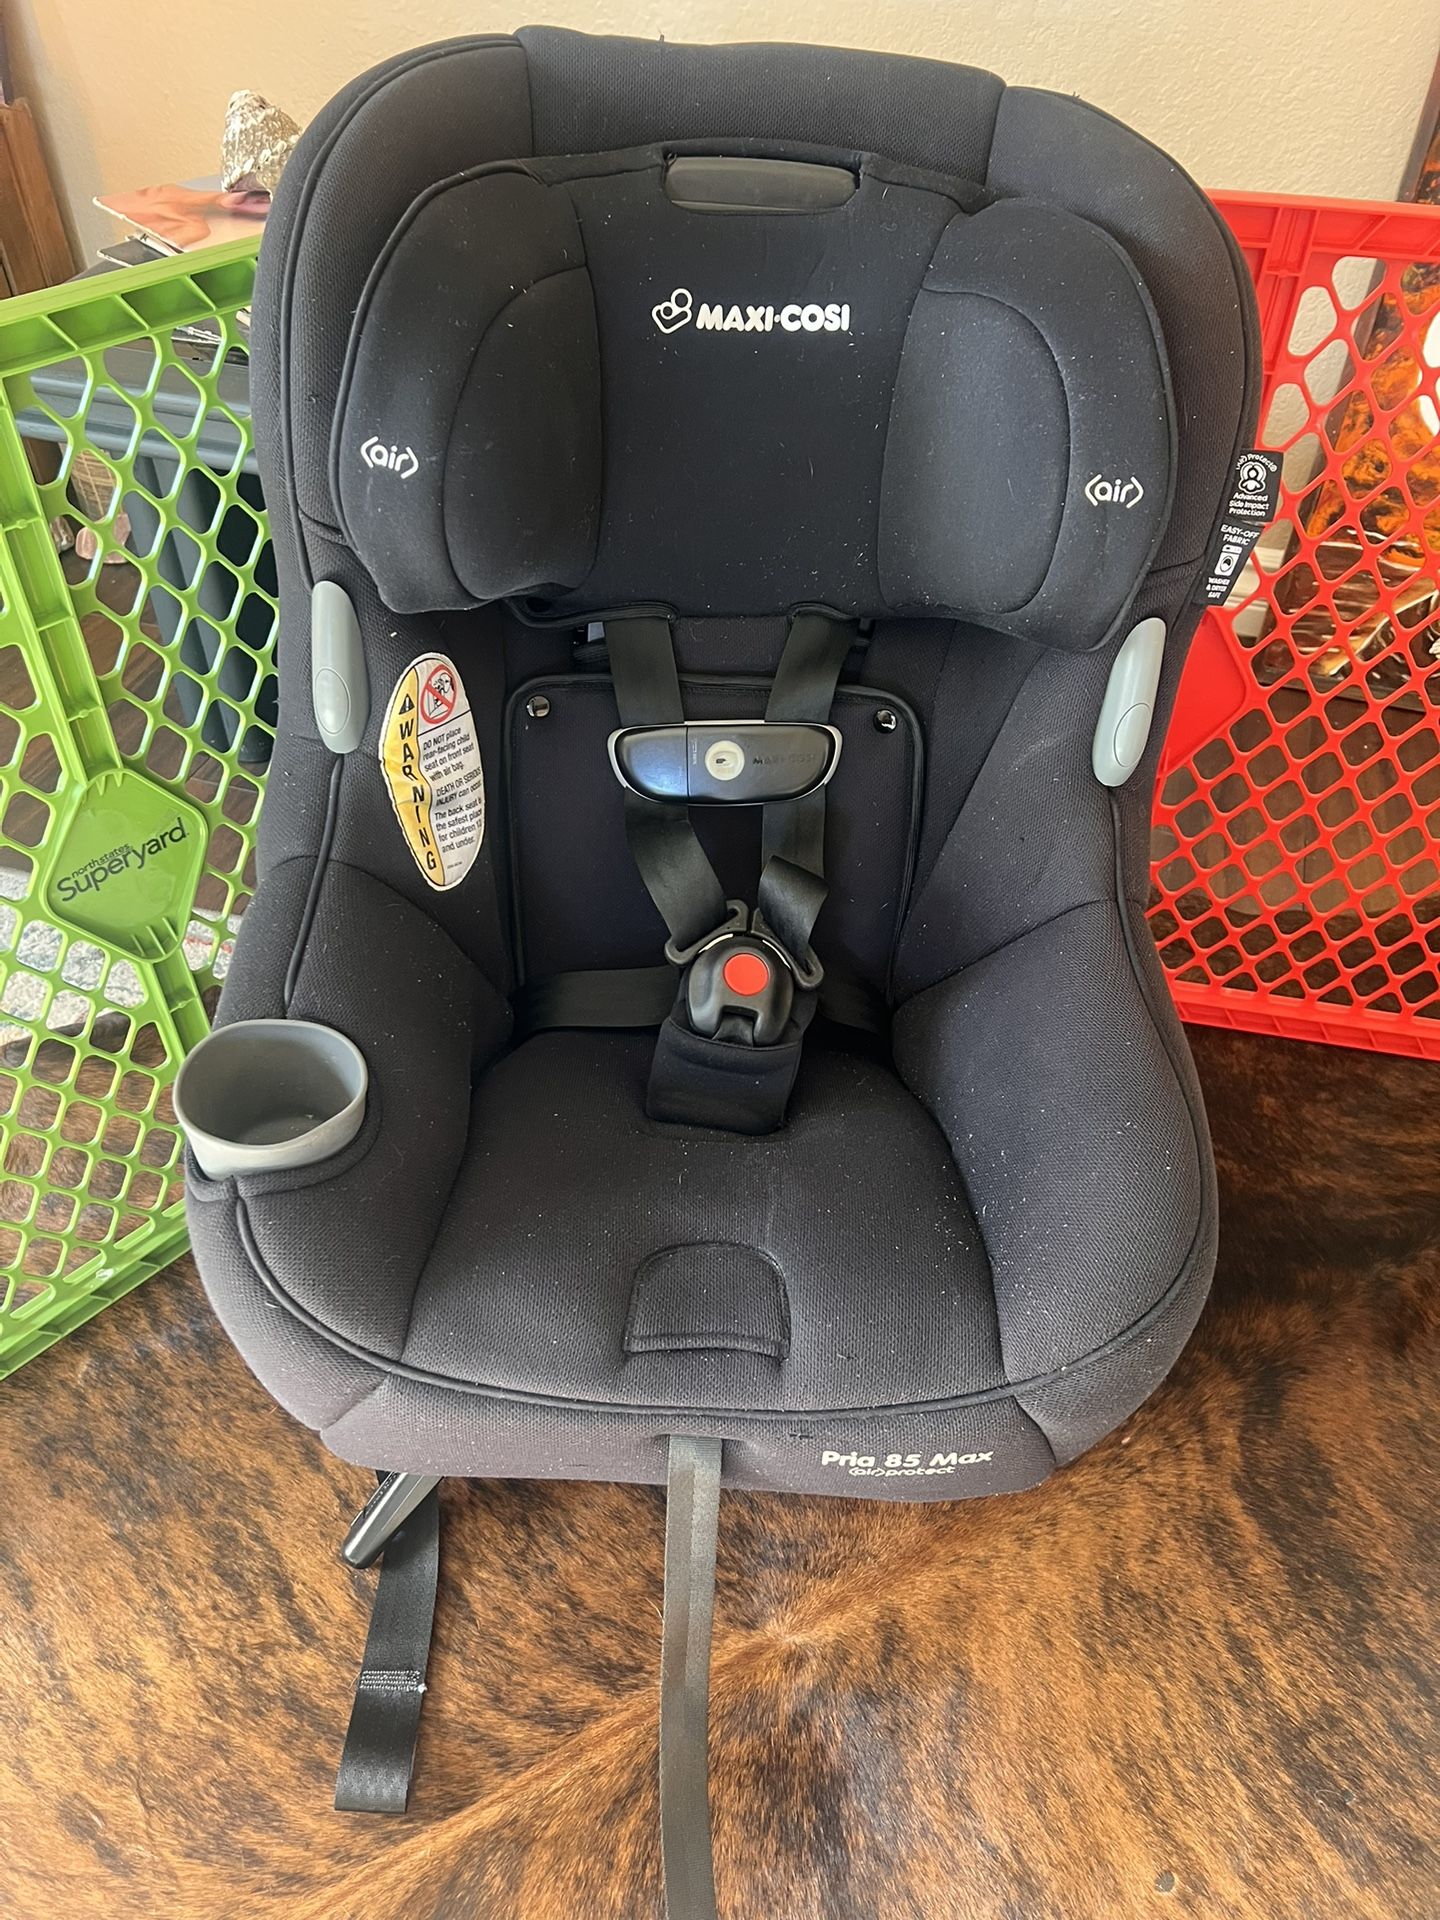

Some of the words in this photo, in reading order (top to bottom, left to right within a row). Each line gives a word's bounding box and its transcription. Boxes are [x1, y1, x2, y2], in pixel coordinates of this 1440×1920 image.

[1229, 500, 1244, 508] Side
[1244, 501, 1269, 510] Impact
[1233, 492, 1268, 502] Advanced
[1229, 507, 1266, 517] Protection
[1220, 524, 1260, 539] EASY-OFF
[1223, 534, 1251, 546] FABRIC
[423, 739, 433, 750] DO
[433, 733, 446, 746] NOT
[446, 727, 461, 741] place
[423, 740, 457, 761] rear-facing
[457, 732, 471, 746] child
[424, 759, 439, 772] seat
[439, 756, 448, 766] on
[447, 748, 463, 761] front
[462, 742, 474, 755] seat
[429, 769, 445, 782] with
[444, 766, 453, 776] air
[436, 782, 456, 797] DEATH
[455, 777, 465, 788] OR
[436, 792, 458, 806] INJURY
[458, 787, 470, 798] can
[435, 811, 448, 821] The
[447, 804, 465, 817] back
[465, 798, 479, 810] seat
[435, 822, 447, 832] the
[447, 814, 469, 828] safest
[438, 833, 449, 843] for
[449, 823, 476, 839] children
[441, 840, 456, 853] and
[56, 816, 187, 902] Superyard
[821, 1450, 876, 1467] Pria
[884, 1452, 923, 1468] 85
[928, 1450, 994, 1467] Max
